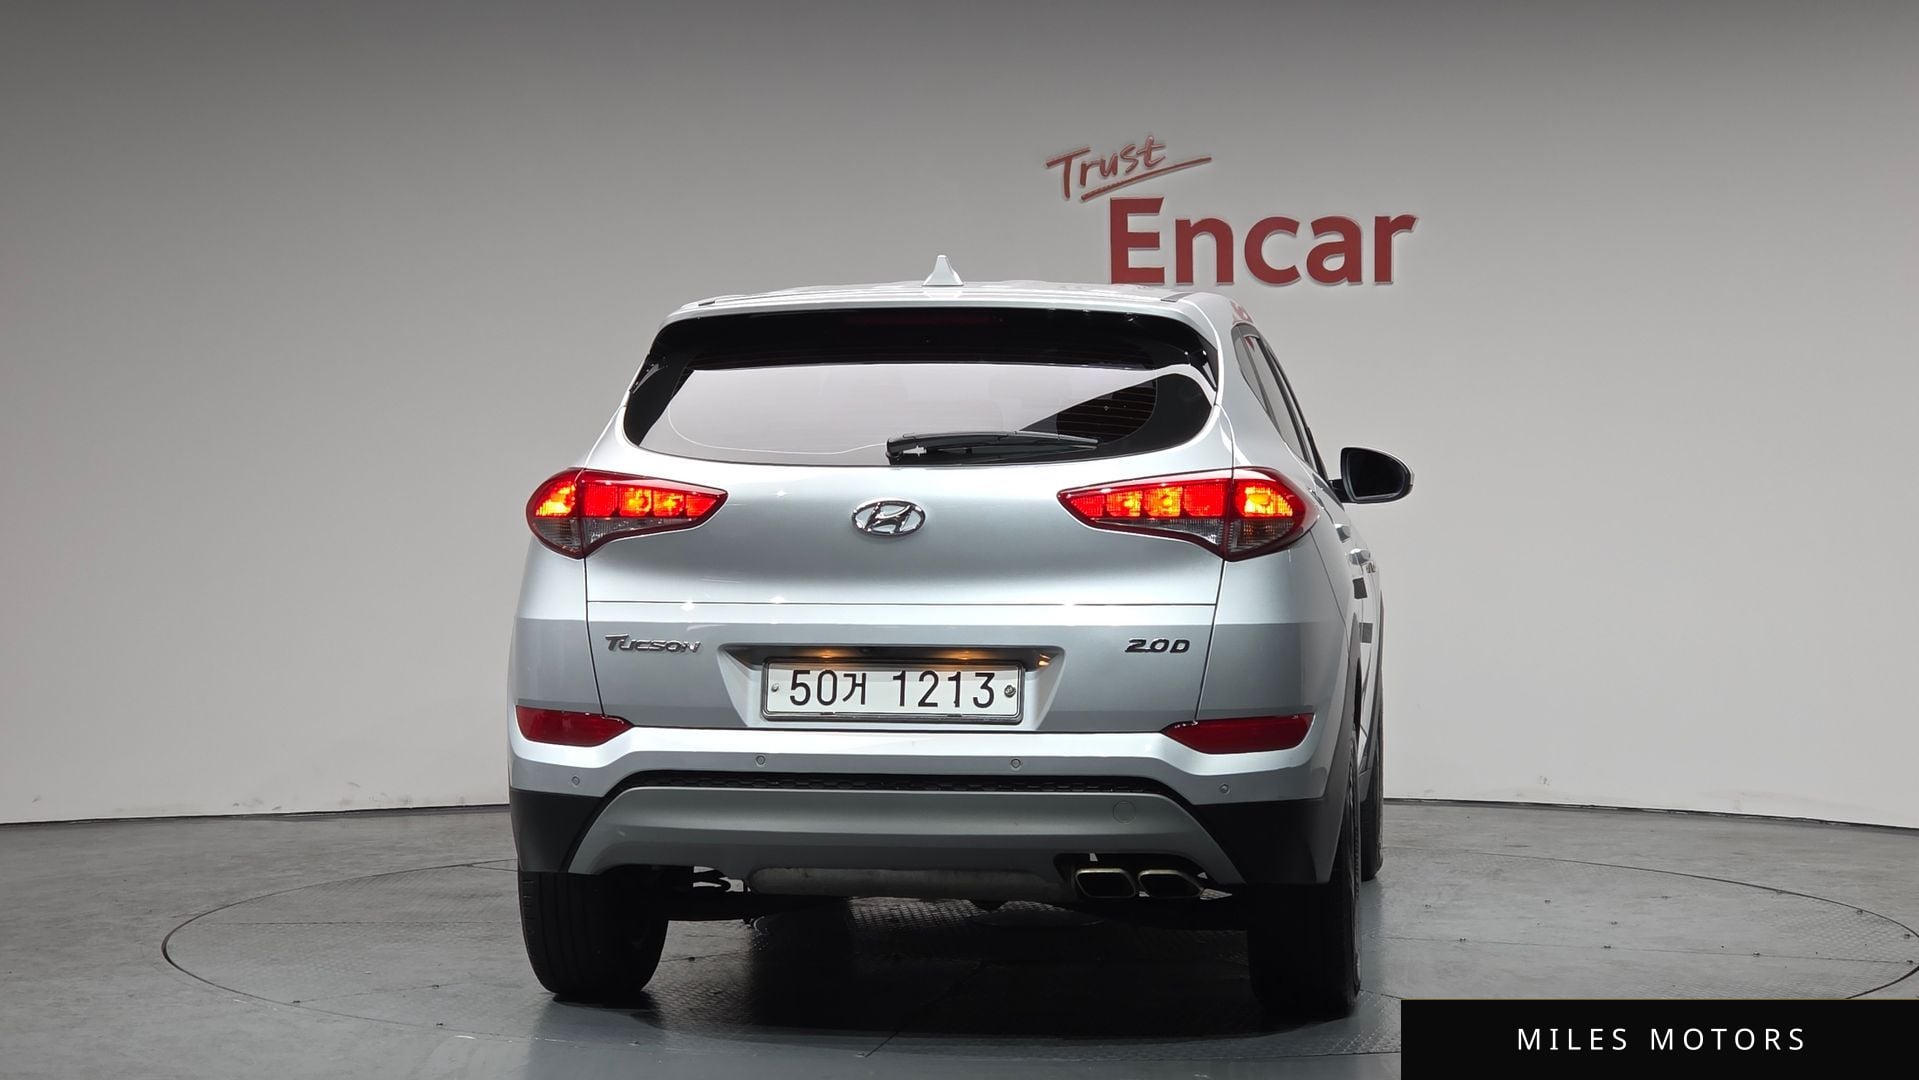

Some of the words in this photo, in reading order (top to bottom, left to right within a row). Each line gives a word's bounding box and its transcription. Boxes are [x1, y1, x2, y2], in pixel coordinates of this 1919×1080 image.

[1045, 135, 1167, 200] Trust
[1109, 196, 1418, 286] Encar
[789, 669, 868, 706] 50거
[892, 669, 996, 709] 1213
